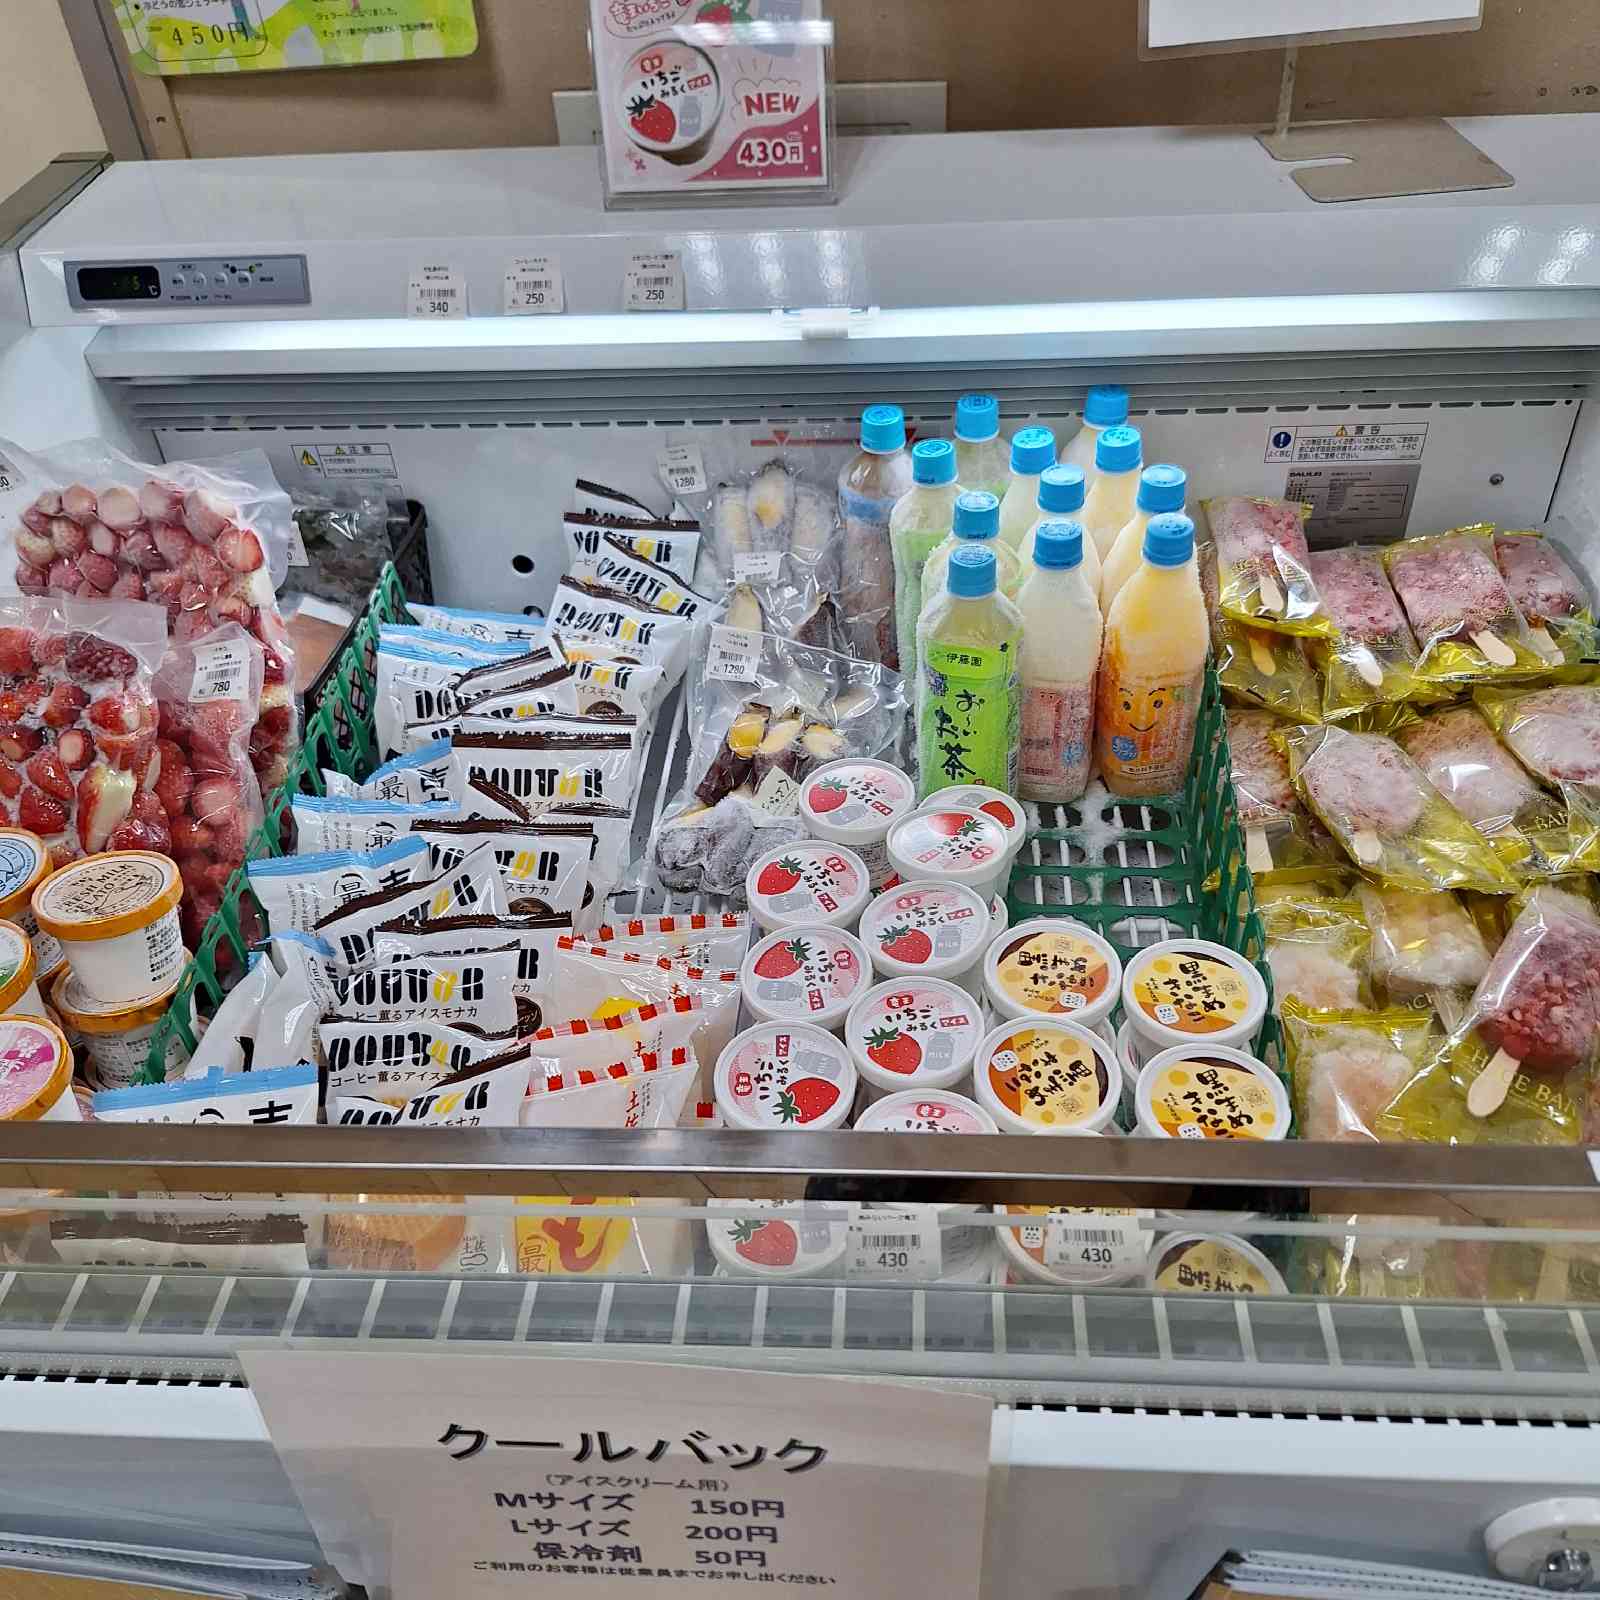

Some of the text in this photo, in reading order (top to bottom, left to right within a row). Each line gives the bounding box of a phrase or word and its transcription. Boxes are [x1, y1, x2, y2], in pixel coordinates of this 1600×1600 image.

[641, 65, 682, 90] いちご
[744, 91, 800, 116] NEW
[739, 140, 804, 166] 430円
[526, 292, 545, 305] 250
[645, 289, 665, 301] 250
[429, 301, 449, 313] 340
[675, 476, 695, 488] 1280
[946, 653, 983, 667] 伊藤園
[723, 663, 745, 675] 1280
[213, 681, 231, 693] 780
[885, 1004, 934, 1023] いちご
[905, 1021, 938, 1033] みるく
[878, 1251, 909, 1268] 430
[1081, 1248, 1112, 1264] 430
[437, 1423, 829, 1474] クールバック
[494, 1492, 786, 1519] Mサイズ 150円
[511, 1519, 779, 1544] Lサイズ 200円
[533, 1542, 768, 1568] 保冷剤 50円
